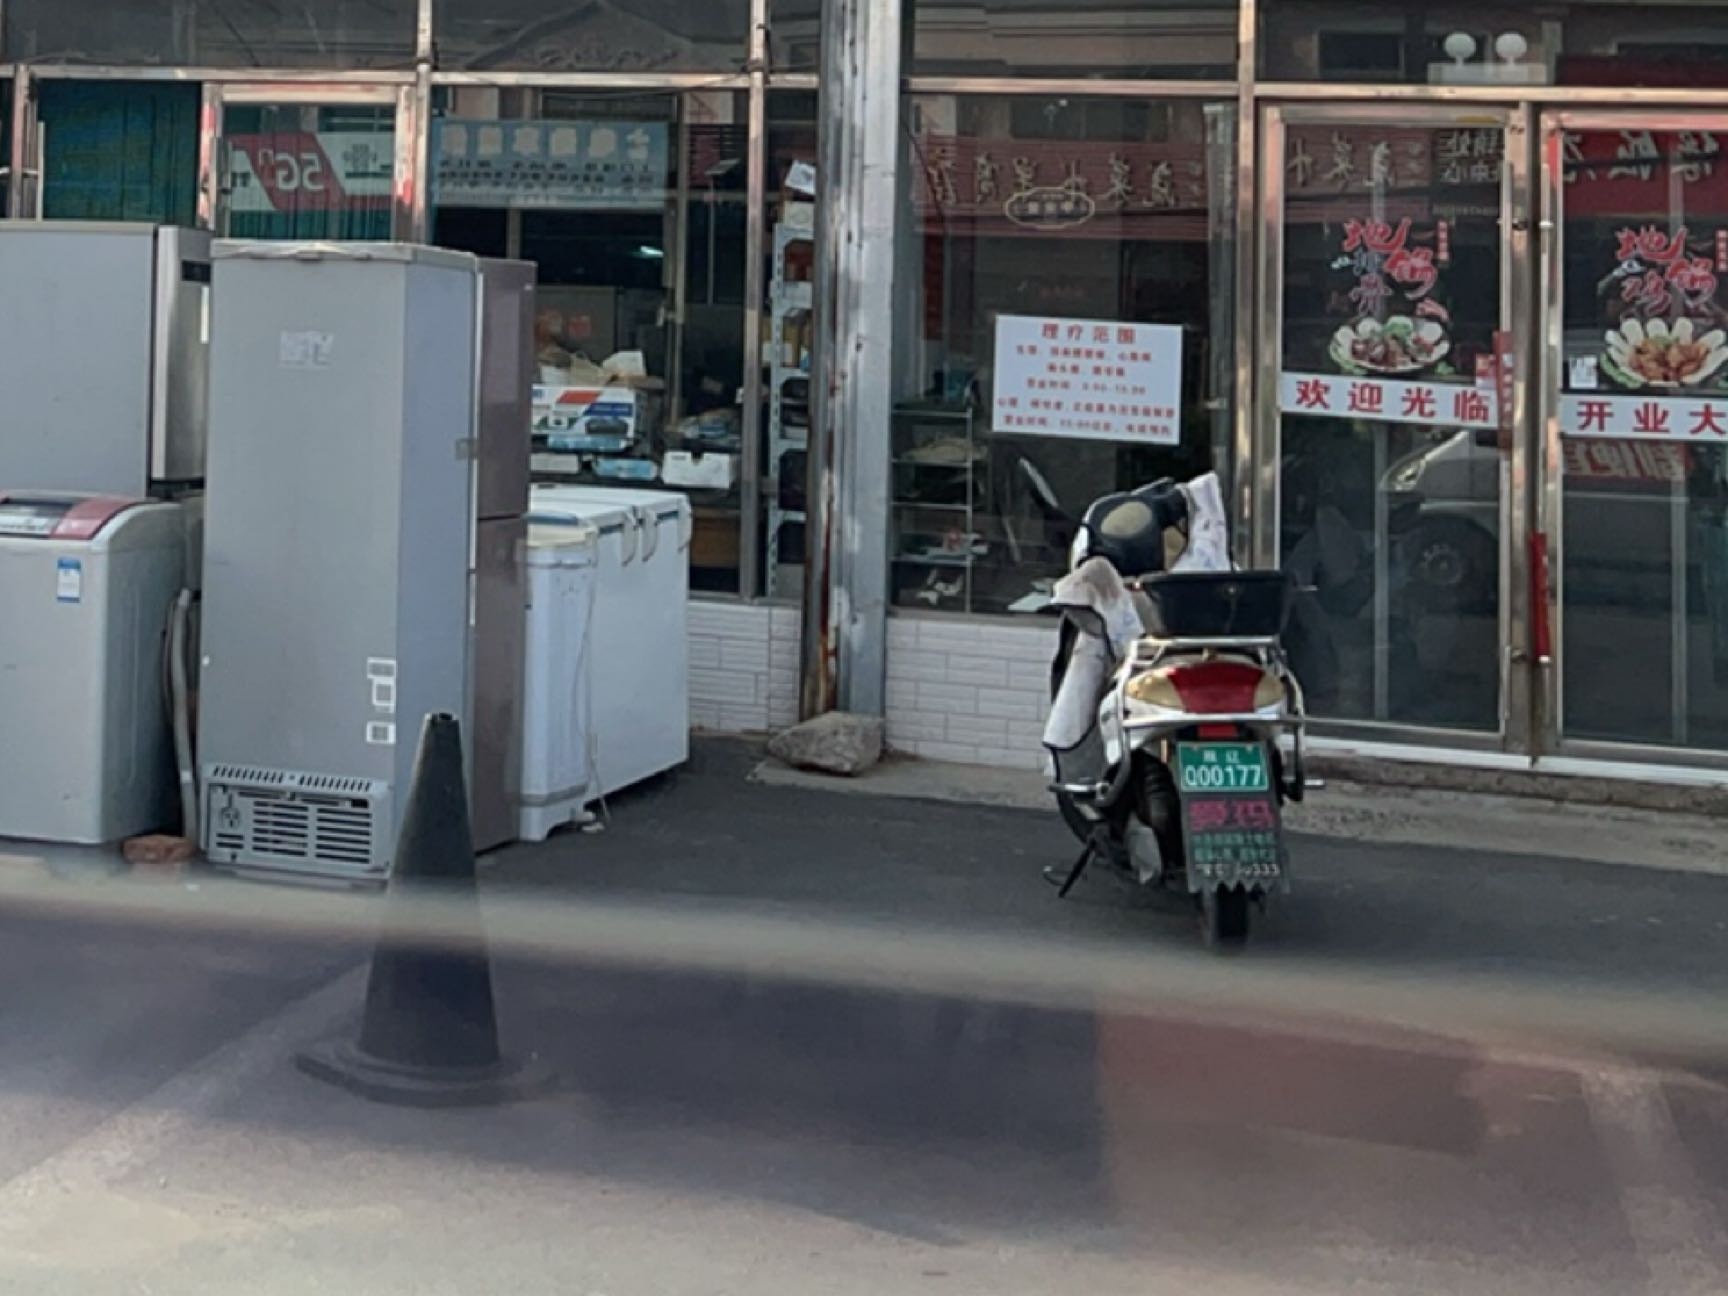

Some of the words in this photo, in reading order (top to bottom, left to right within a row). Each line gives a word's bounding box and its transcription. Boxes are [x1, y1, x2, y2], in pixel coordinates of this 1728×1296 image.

[1295, 379, 1490, 424] 欢迎光临
[1576, 400, 1728, 436] 开业大
